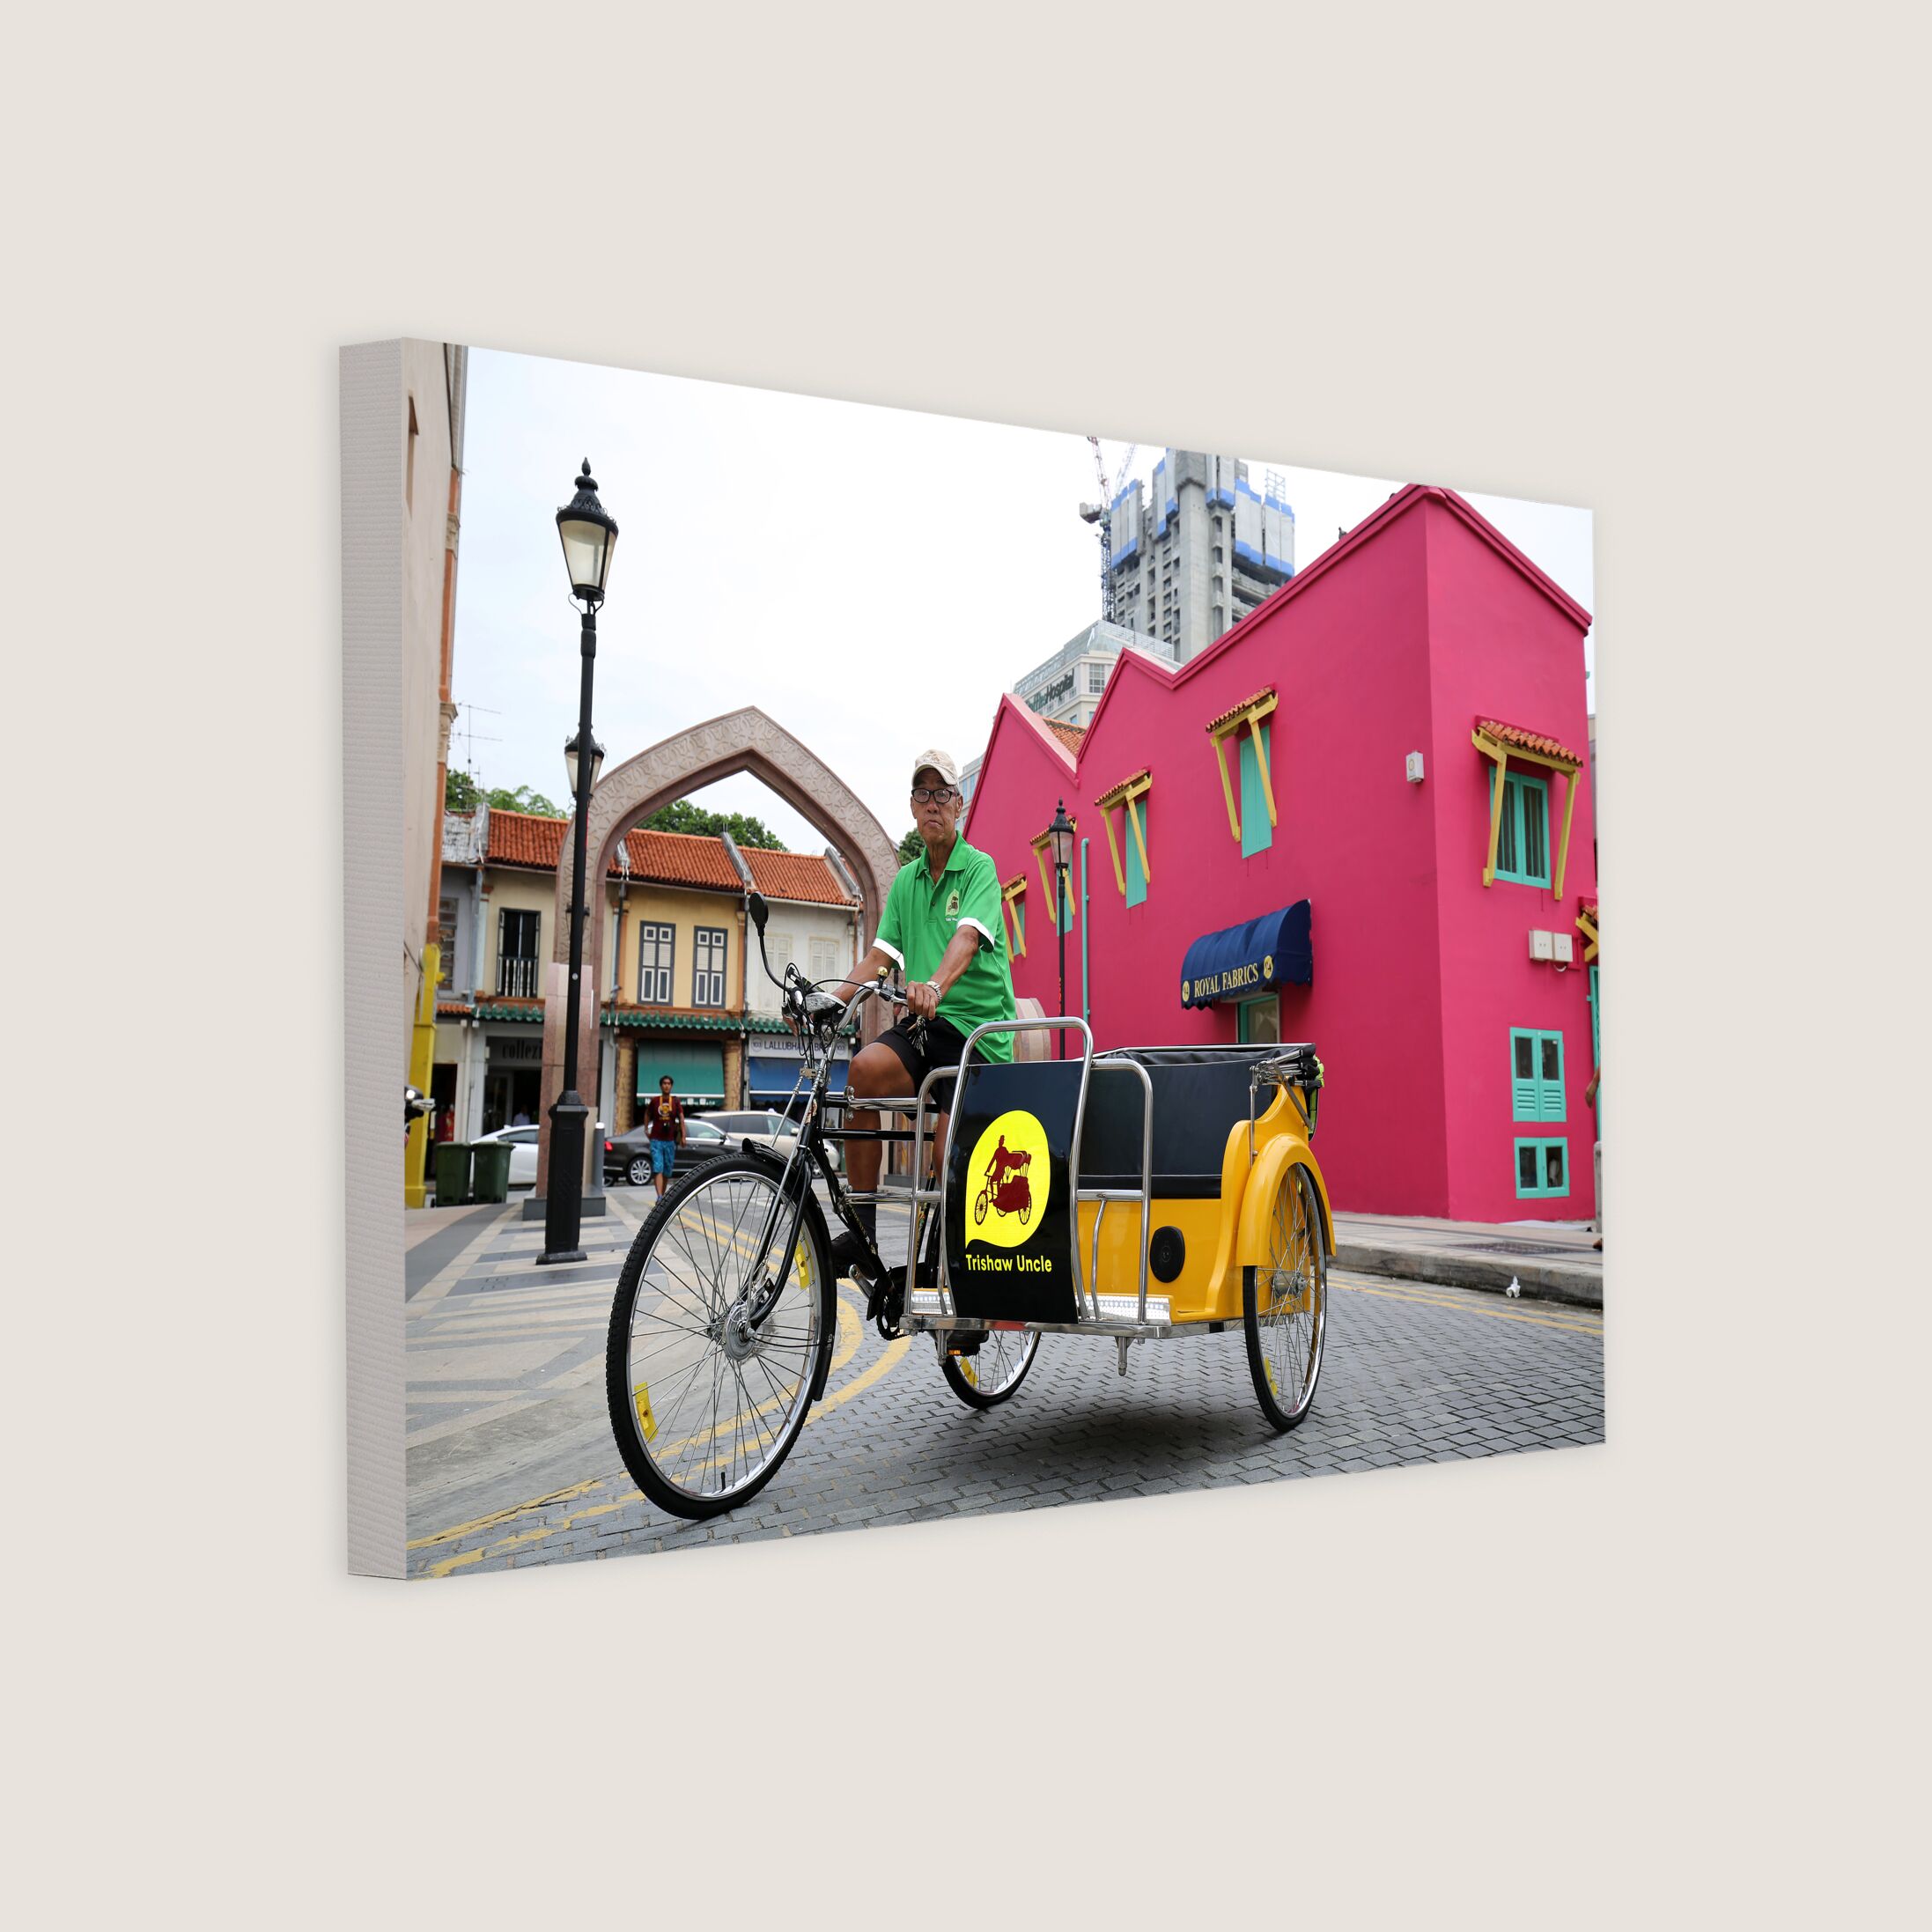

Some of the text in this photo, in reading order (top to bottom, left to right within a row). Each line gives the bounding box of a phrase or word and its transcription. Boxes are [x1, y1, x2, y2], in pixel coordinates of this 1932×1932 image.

[1194, 975, 1220, 998] ROYAL
[1222, 962, 1259, 992] FABRICS
[965, 1254, 1052, 1272] Trishaw Uncle
